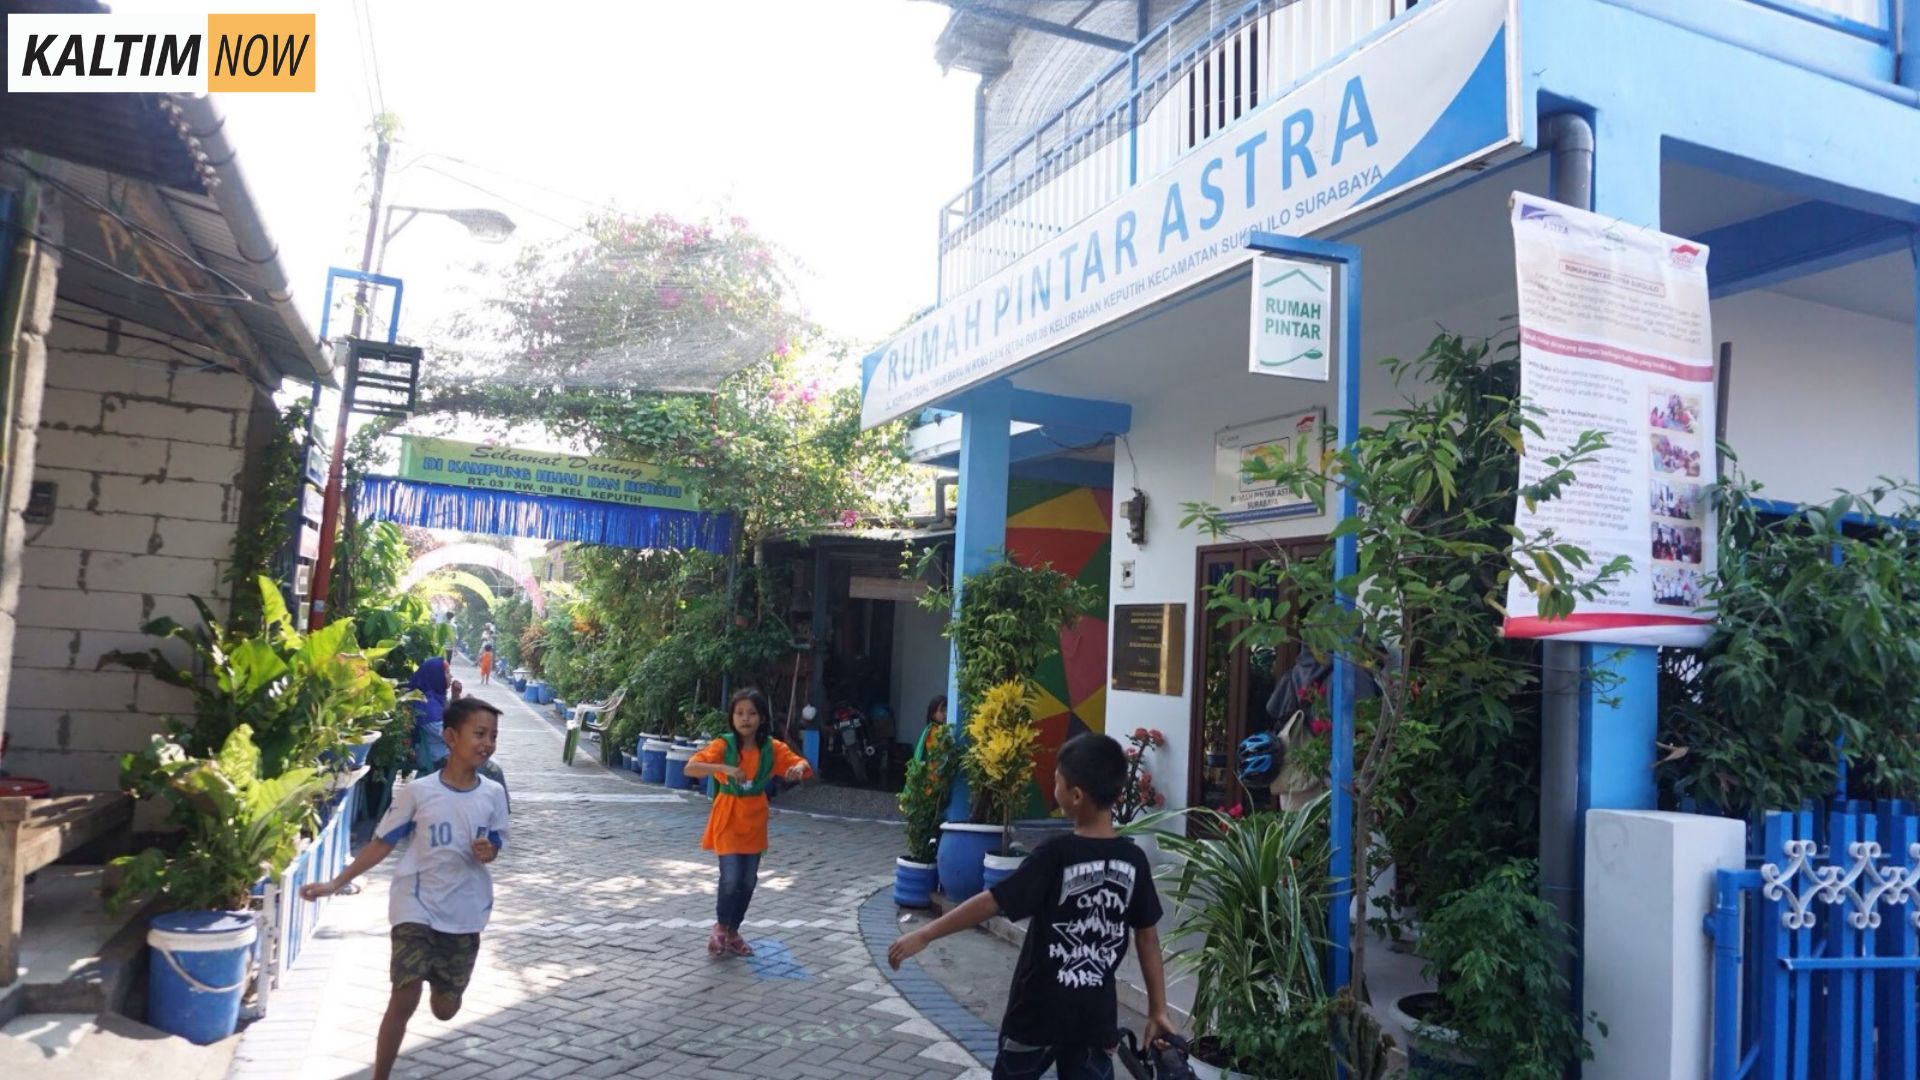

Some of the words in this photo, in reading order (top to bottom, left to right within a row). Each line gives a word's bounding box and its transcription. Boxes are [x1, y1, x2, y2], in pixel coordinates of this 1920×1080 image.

[887, 296, 982, 392] RUMAH
[993, 211, 1138, 338] PINTAR
[1158, 75, 1379, 254] ASTRA
[1050, 306, 1101, 335] KELURAHAN
[1103, 279, 1146, 308] KEPUTIH
[1148, 243, 1218, 288] KECAMATAN
[1295, 165, 1383, 219] SURABAYA
[1266, 297, 1321, 319] RUMAH
[1265, 318, 1321, 340] PINTAR
[423, 456, 443, 471] DI
[448, 459, 532, 481] KAMPUNG
[536, 468, 583, 487] HIJAU
[587, 475, 621, 492] DAN
[470, 445, 562, 467] Selamat
[568, 456, 643, 479] Datang
[467, 477, 486, 487] RT.
[489, 479, 504, 489] 03
[515, 482, 537, 492] RW.
[540, 484, 554, 494] 08
[561, 487, 586, 498] KEL.
[591, 490, 643, 504] KEPUTIH
[428, 822, 452, 847] 10
